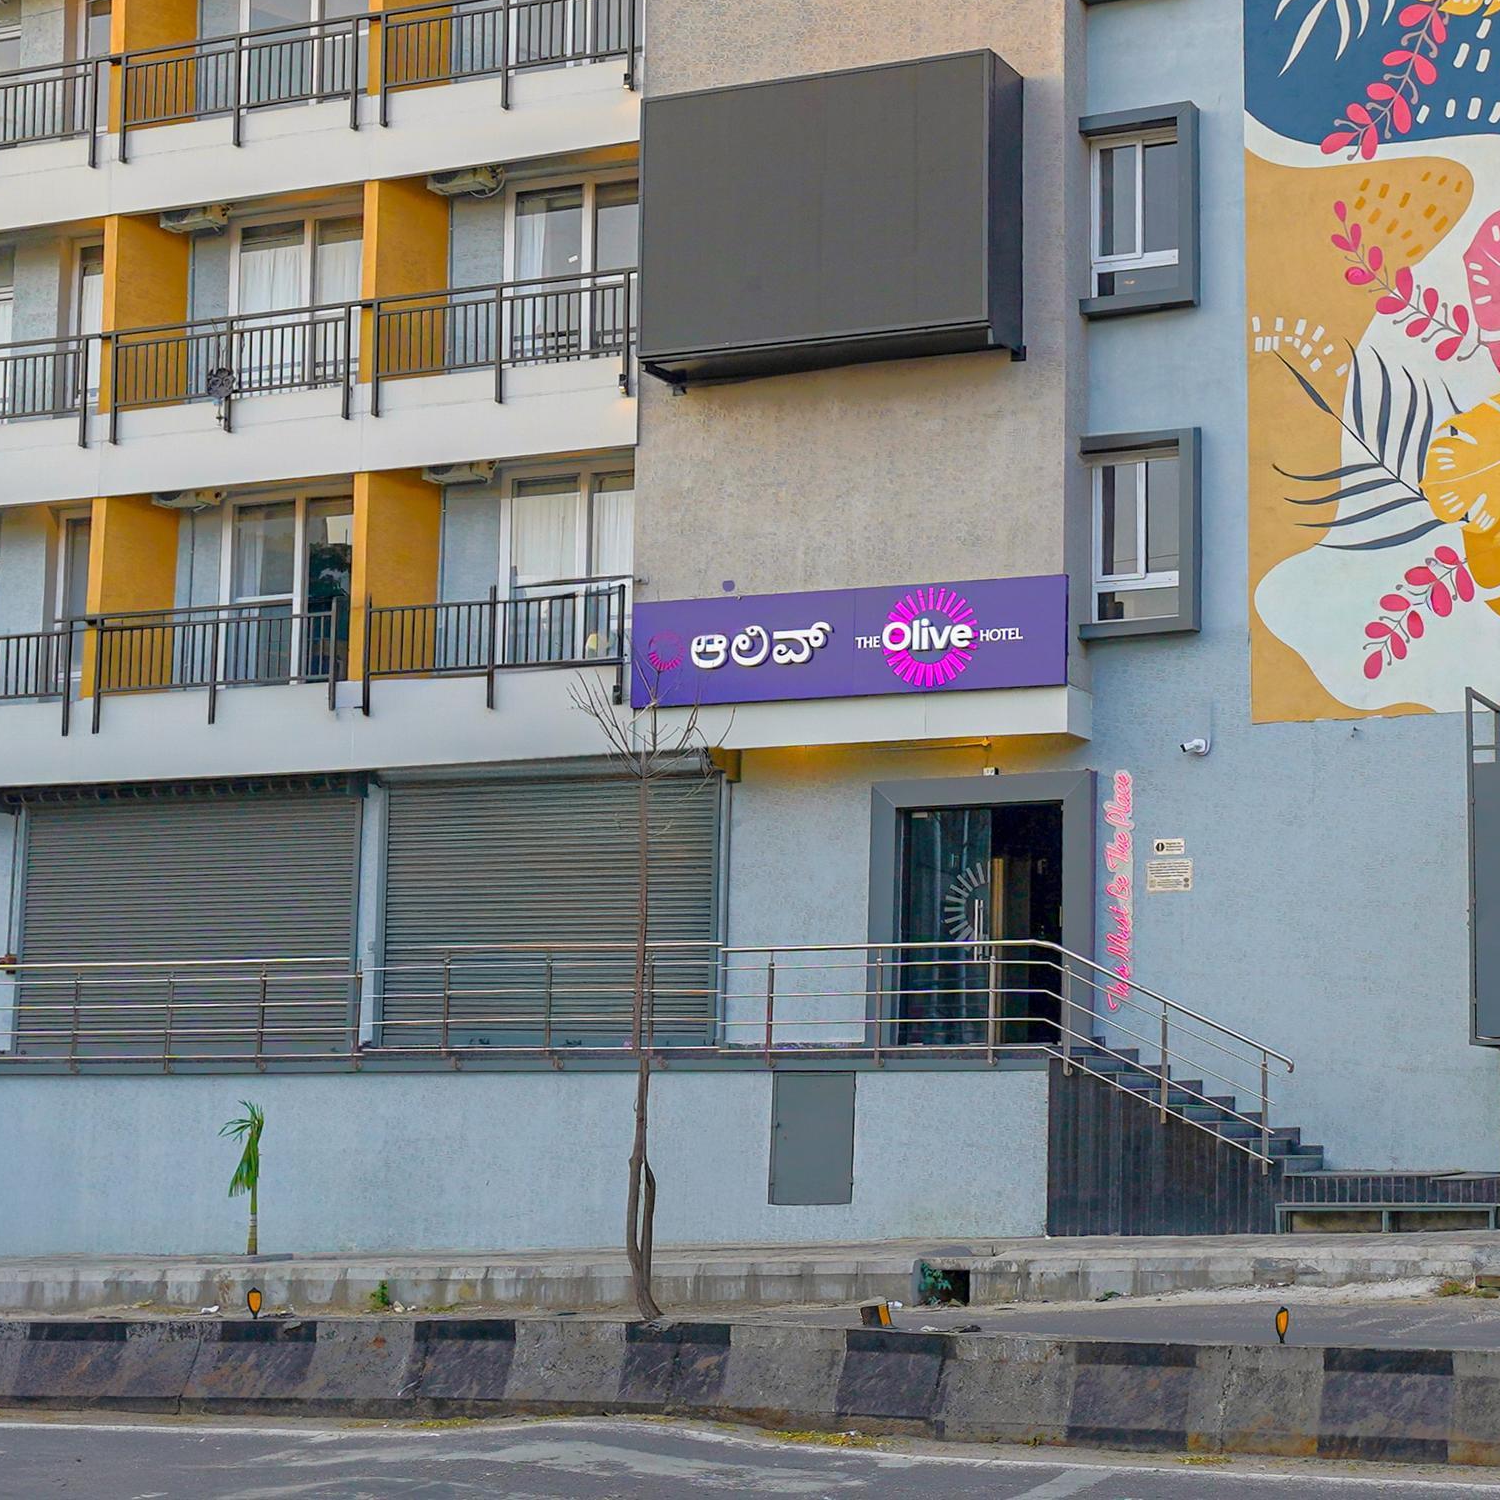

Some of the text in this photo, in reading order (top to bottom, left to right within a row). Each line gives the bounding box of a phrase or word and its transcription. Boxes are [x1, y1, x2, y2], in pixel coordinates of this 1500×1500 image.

[855, 617, 1024, 652] THE Olive HOTEL
[1104, 773, 1132, 827] Place
[1106, 875, 1130, 901] Be
[1106, 905, 1131, 963] Must
